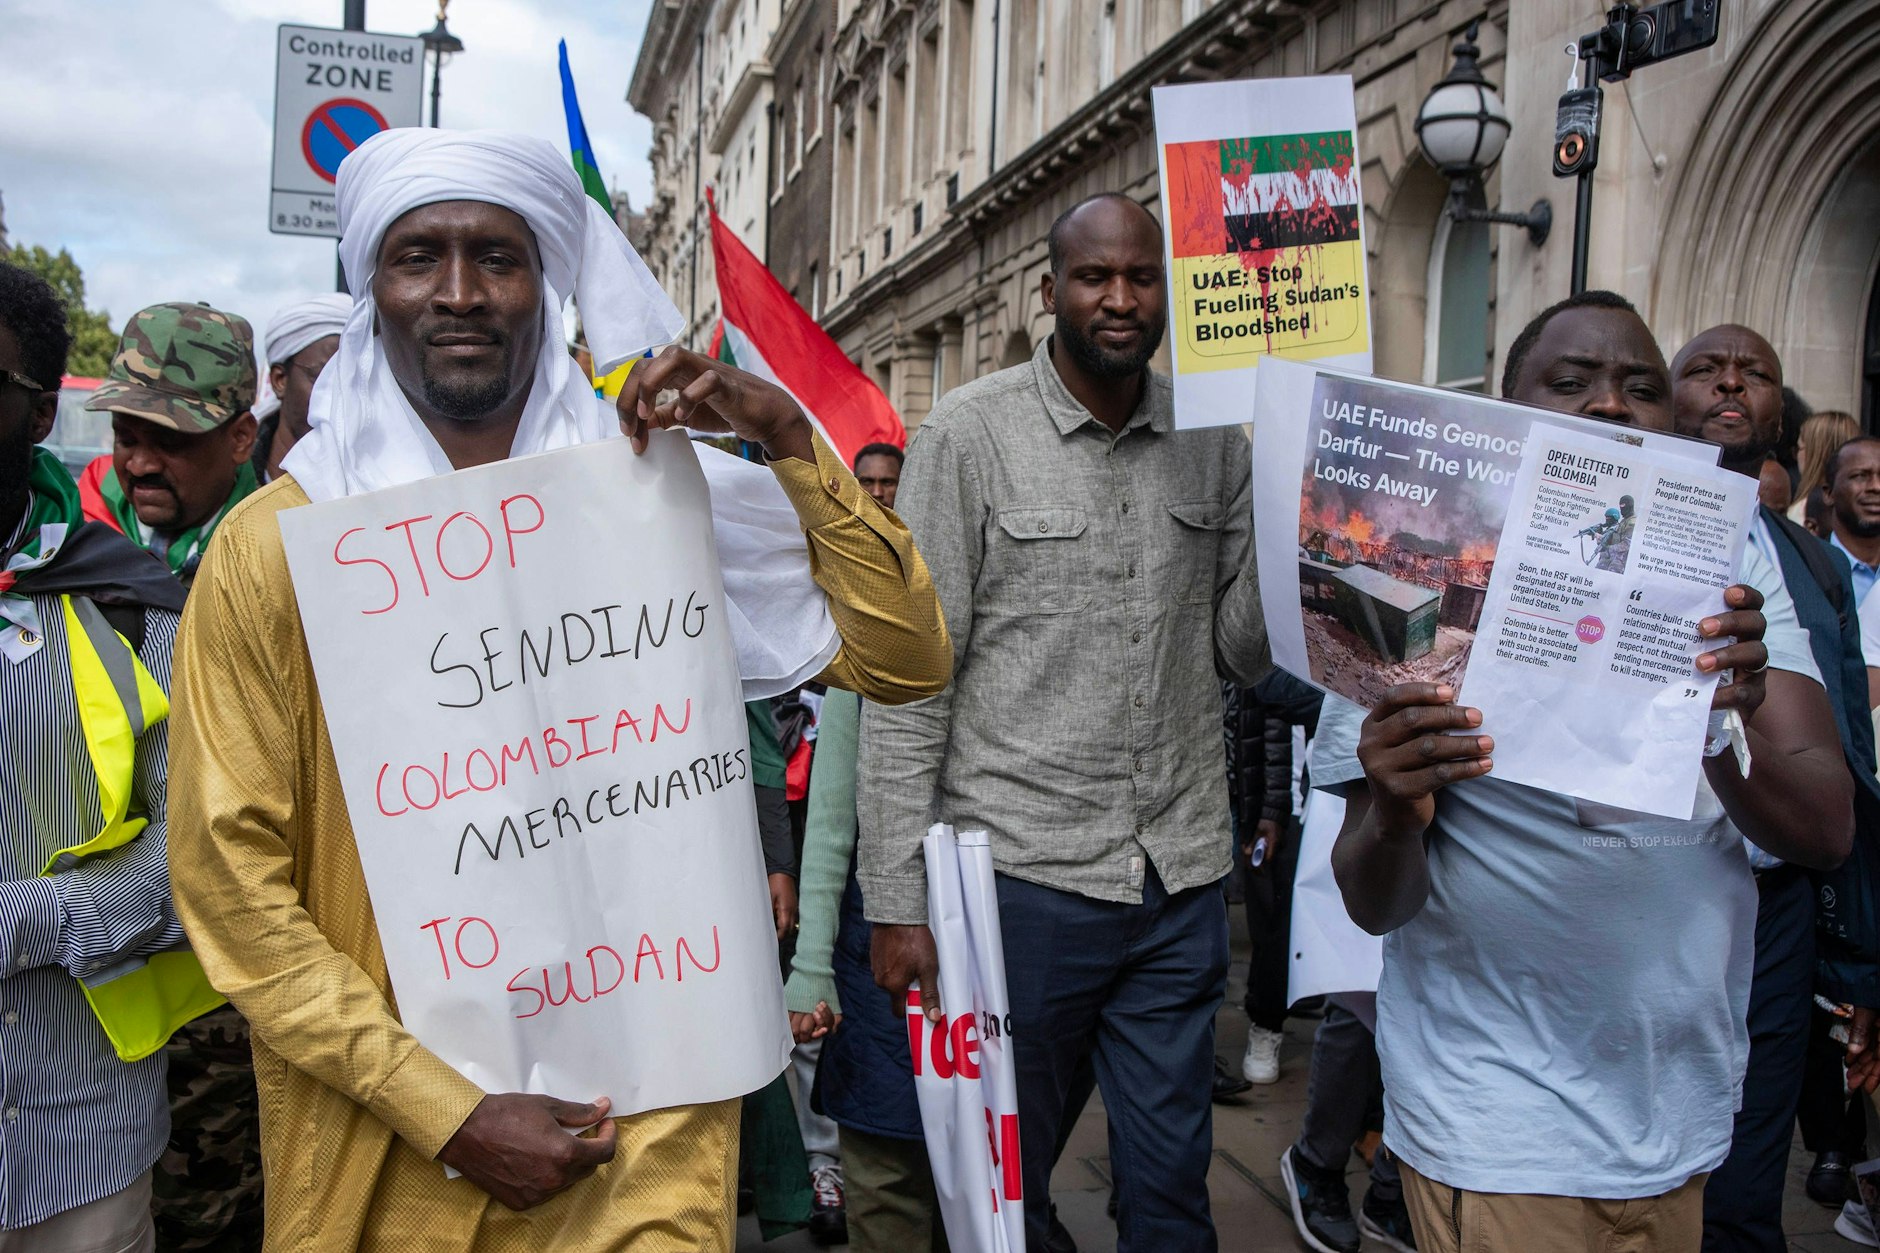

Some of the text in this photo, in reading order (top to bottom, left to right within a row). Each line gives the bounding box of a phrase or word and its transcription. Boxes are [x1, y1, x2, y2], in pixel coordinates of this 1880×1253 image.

[289, 35, 413, 64] Controlled
[306, 63, 393, 92] ZONE
[277, 213, 313, 228] 8.30
[1192, 266, 1303, 290] UAE: Stop
[1194, 283, 1360, 316] Fueling Sudan’s
[1196, 312, 1310, 341] Bloodshed
[1322, 399, 1528, 458] UAE Funds Genoci
[1317, 429, 1382, 460] Darfur
[1416, 448, 1460, 476] The
[1466, 458, 1517, 486] Wor
[1547, 449, 1630, 479] OPEN LETTER TO
[1314, 458, 1438, 507] Looks Away
[1543, 463, 1597, 487] COLOMBIA
[1539, 485, 1606, 508] Colombian Mercenaries
[1655, 488, 1679, 501] People
[1689, 496, 1722, 512] Colombia:
[1658, 478, 1726, 502] President Petro and
[1534, 503, 1580, 520] for UAE-Backed
[1536, 494, 1590, 514] Must Stop Fighting
[1652, 502, 1663, 510] Your
[1665, 506, 1698, 519] mercenaries,
[1700, 514, 1722, 524] recruited
[1529, 521, 1549, 532] Sudan
[1532, 512, 1544, 521] RSF
[1545, 514, 1562, 525] Militia
[1650, 510, 1666, 519] rulers,
[1678, 516, 1692, 526] being
[1693, 520, 1706, 528] used
[1658, 521, 1684, 531] genocidal
[1696, 530, 1715, 538] against
[1646, 526, 1663, 534] people
[1671, 531, 1688, 540] Sudan.
[1690, 535, 1706, 544] These
[1654, 536, 1670, 545] aiding
[333, 493, 546, 615] STOP
[1534, 543, 1548, 552] UNITED
[1550, 546, 1570, 555] KINGDOM
[1642, 540, 1658, 550] killing
[1659, 545, 1680, 554] civilians
[1701, 555, 1717, 564] deadly
[1518, 562, 1593, 587] Soon, the RSF will be
[1638, 563, 1653, 572] away
[1654, 566, 1668, 574] from
[1669, 569, 1680, 578] this
[1680, 574, 1709, 585] murderous
[1640, 553, 1649, 561] We
[1650, 556, 1664, 565] urge
[1665, 560, 1675, 568] you
[1684, 564, 1698, 573] keep
[1712, 573, 1729, 581] people
[1513, 584, 1583, 607] organisation by the
[1515, 573, 1600, 600] designated as a terrorist
[1510, 593, 1561, 612] United States.
[1504, 616, 1569, 639] Colombia is better
[1626, 604, 1700, 630] Countries build stro
[1501, 628, 1578, 652] than to be associated
[1580, 623, 1600, 636] STOP
[1619, 629, 1686, 651] peace and mutual
[1623, 617, 1704, 644] relationships through
[430, 590, 710, 708] SENDING
[1496, 648, 1549, 667] their atrocities.
[1498, 639, 1515, 649] with
[1516, 643, 1533, 654] such
[1541, 648, 1561, 660] group
[1616, 640, 1692, 665] respect, not through
[1611, 663, 1668, 684] to kill strangers.
[1614, 652, 1691, 677] sending mercenaries
[376, 697, 692, 817] COLOMBIAN
[454, 748, 749, 875] MERCENARIES
[1582, 836, 1627, 848] NEVER
[1630, 835, 1661, 848] STOP
[420, 916, 500, 980] TO
[507, 925, 721, 1019] SUDAN
